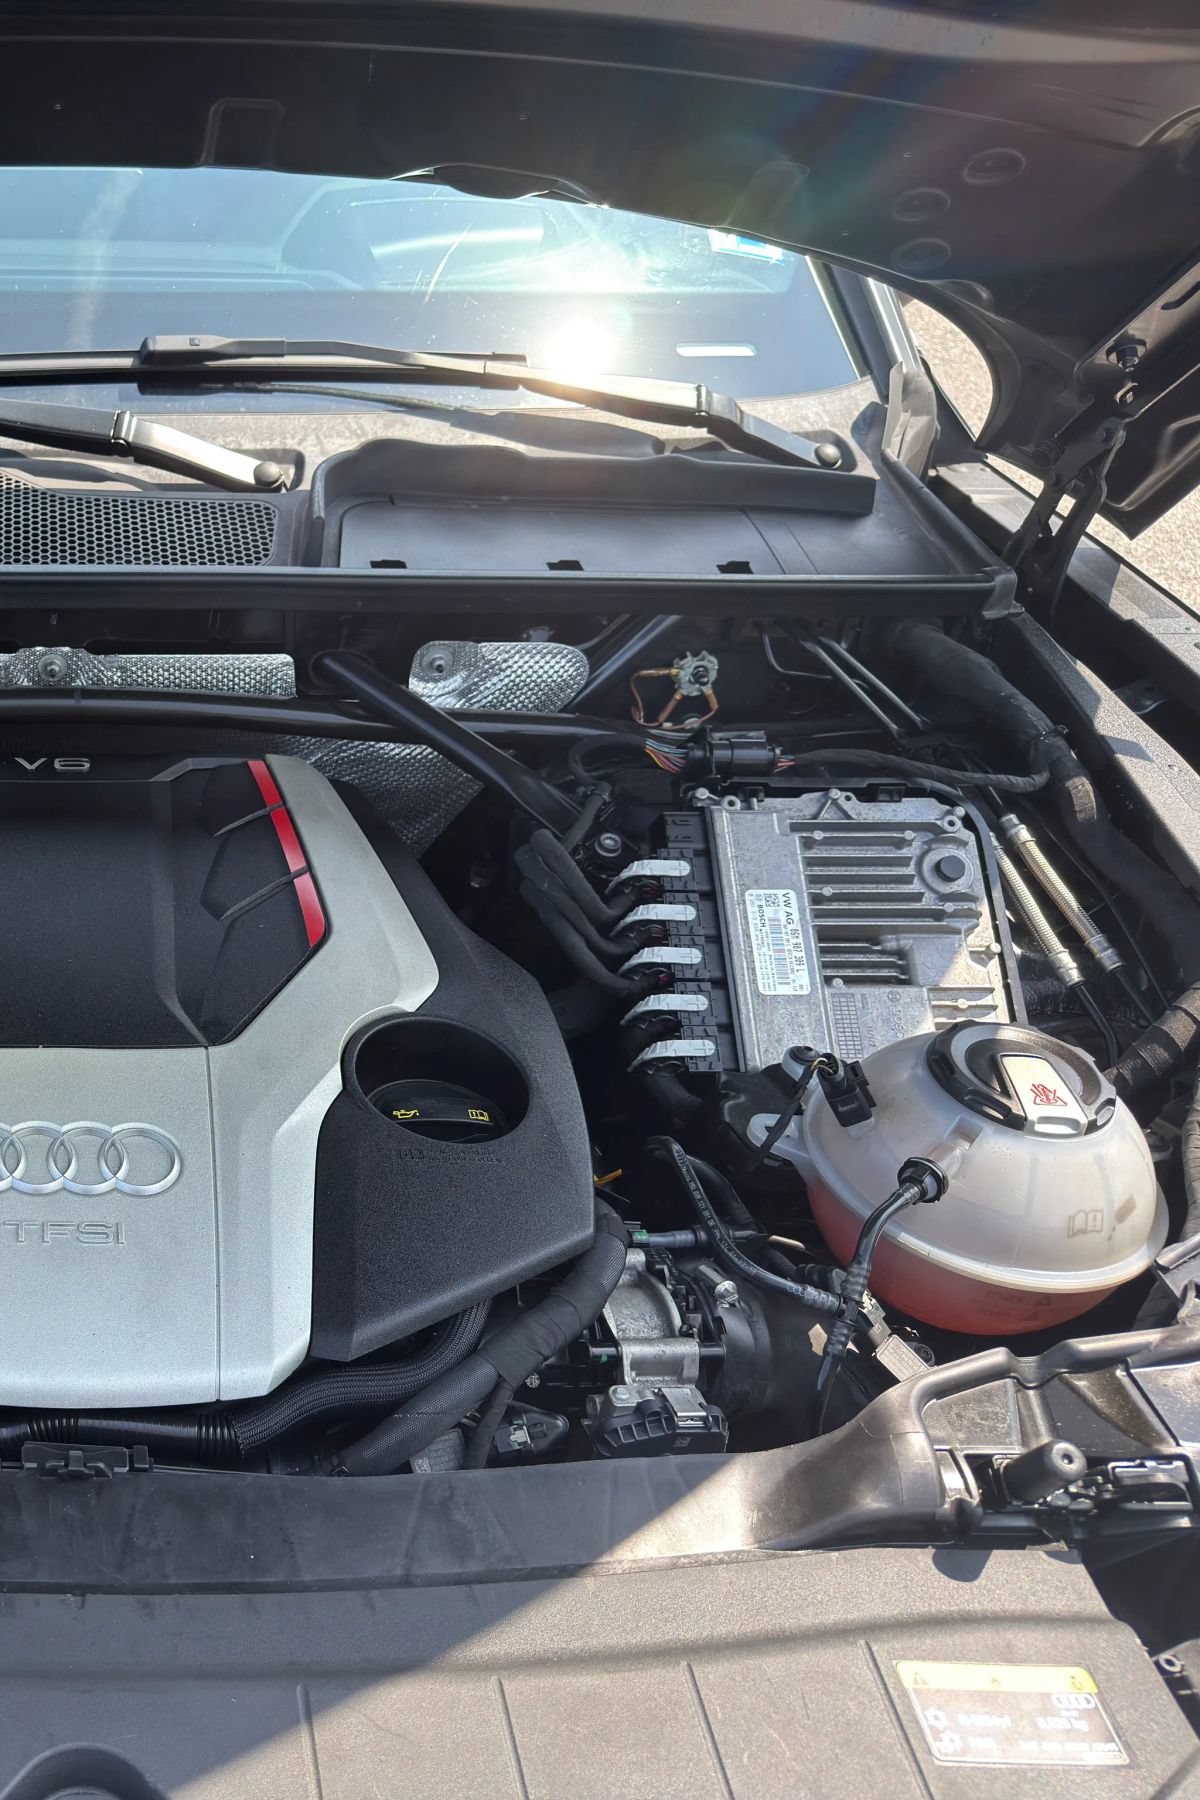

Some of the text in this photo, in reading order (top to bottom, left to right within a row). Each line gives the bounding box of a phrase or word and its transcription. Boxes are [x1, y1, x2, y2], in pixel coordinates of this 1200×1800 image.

[14, 756, 91, 772] V6
[782, 892, 792, 909] VW
[757, 904, 766, 928] BOSCH
[785, 910, 794, 925] AG
[4, 1220, 126, 1246] TFSI
